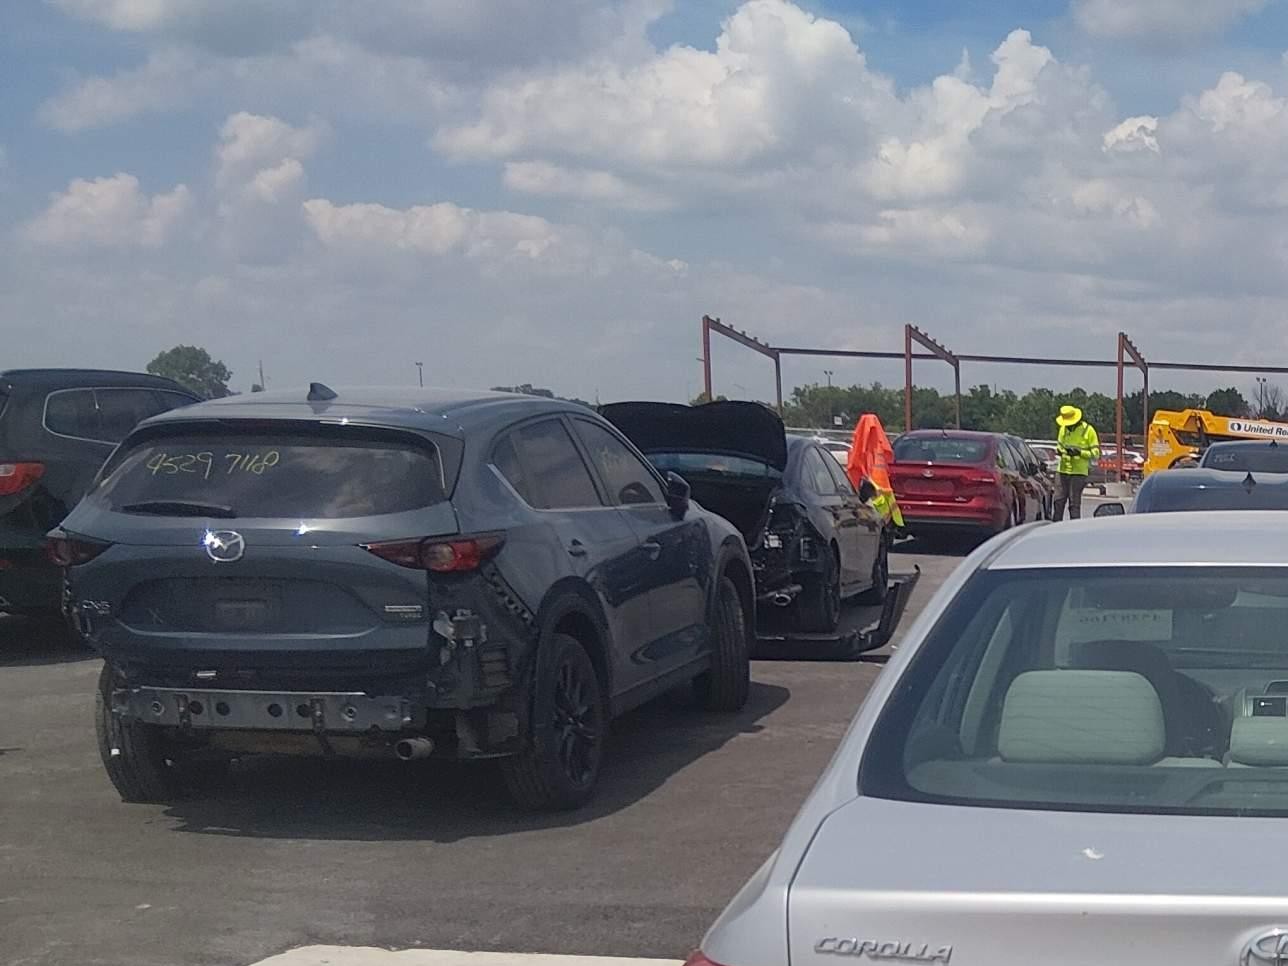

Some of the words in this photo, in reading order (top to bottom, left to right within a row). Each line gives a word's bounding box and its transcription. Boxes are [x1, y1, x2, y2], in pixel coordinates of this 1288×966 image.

[1243, 423, 1274, 435] United
[146, 451, 213, 479] 4529
[815, 936, 953, 966] COROLLA
